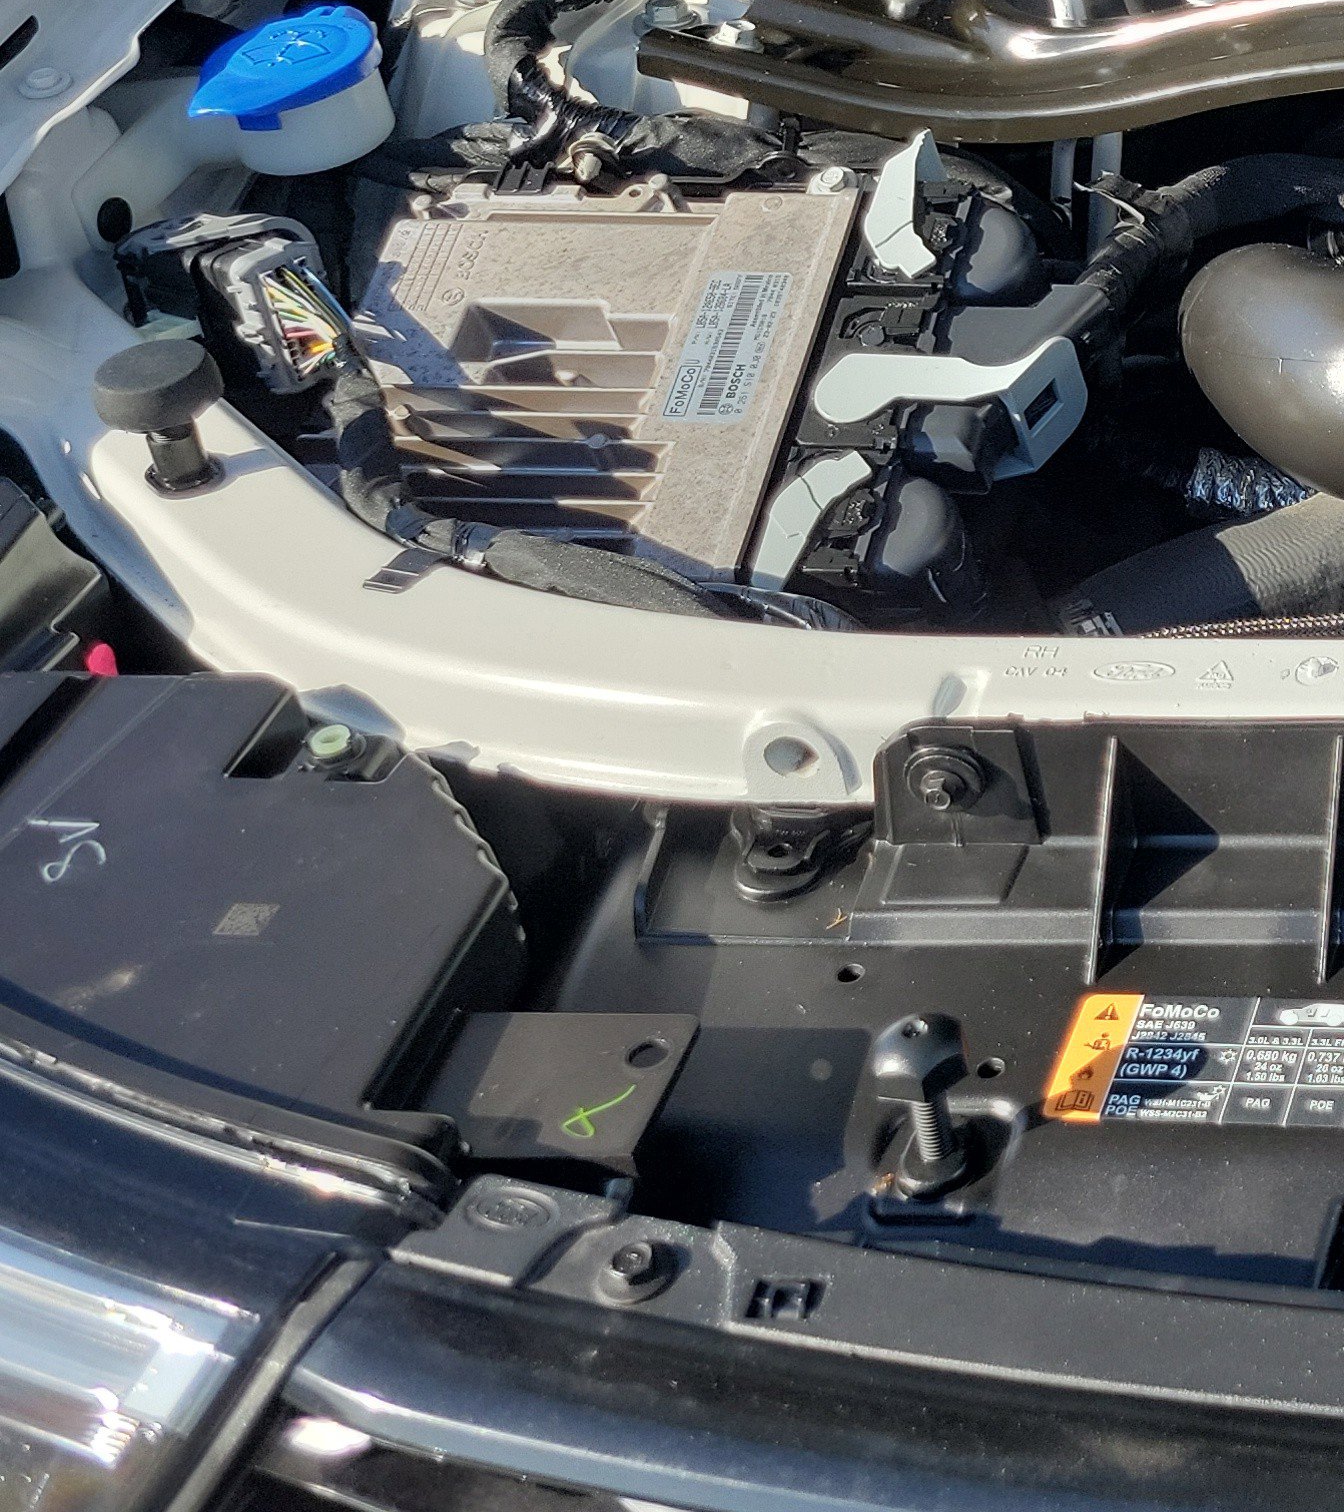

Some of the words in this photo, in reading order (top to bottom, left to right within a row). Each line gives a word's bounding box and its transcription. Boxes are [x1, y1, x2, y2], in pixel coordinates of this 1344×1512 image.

[726, 364, 746, 399] BOSCH
[670, 367, 696, 414] FoMoCo
[1023, 644, 1060, 659] RH
[1138, 1003, 1221, 1020] FoMoCo
[1136, 1020, 1165, 1030] SAE
[1165, 1020, 1197, 1030] J639
[1282, 1037, 1304, 1046] 3.3L
[1310, 1038, 1332, 1046] 3.3L
[1125, 1047, 1201, 1063] R-1234yf
[1246, 1049, 1280, 1061] 0.680
[1281, 1050, 1298, 1064] kg
[1307, 1051, 1341, 1063] 0.737
[1119, 1063, 1168, 1078] (GWP
[1170, 1064, 1188, 1079] 4)
[1254, 1061, 1268, 1071] 24
[1269, 1063, 1283, 1072] oz
[1330, 1065, 1344, 1074] oz
[1268, 1072, 1286, 1082] lbs
[1108, 1094, 1141, 1105] PAG
[1245, 1098, 1271, 1108] PAG
[1309, 1100, 1335, 1110] POE
[1104, 1105, 1138, 1116] POE
